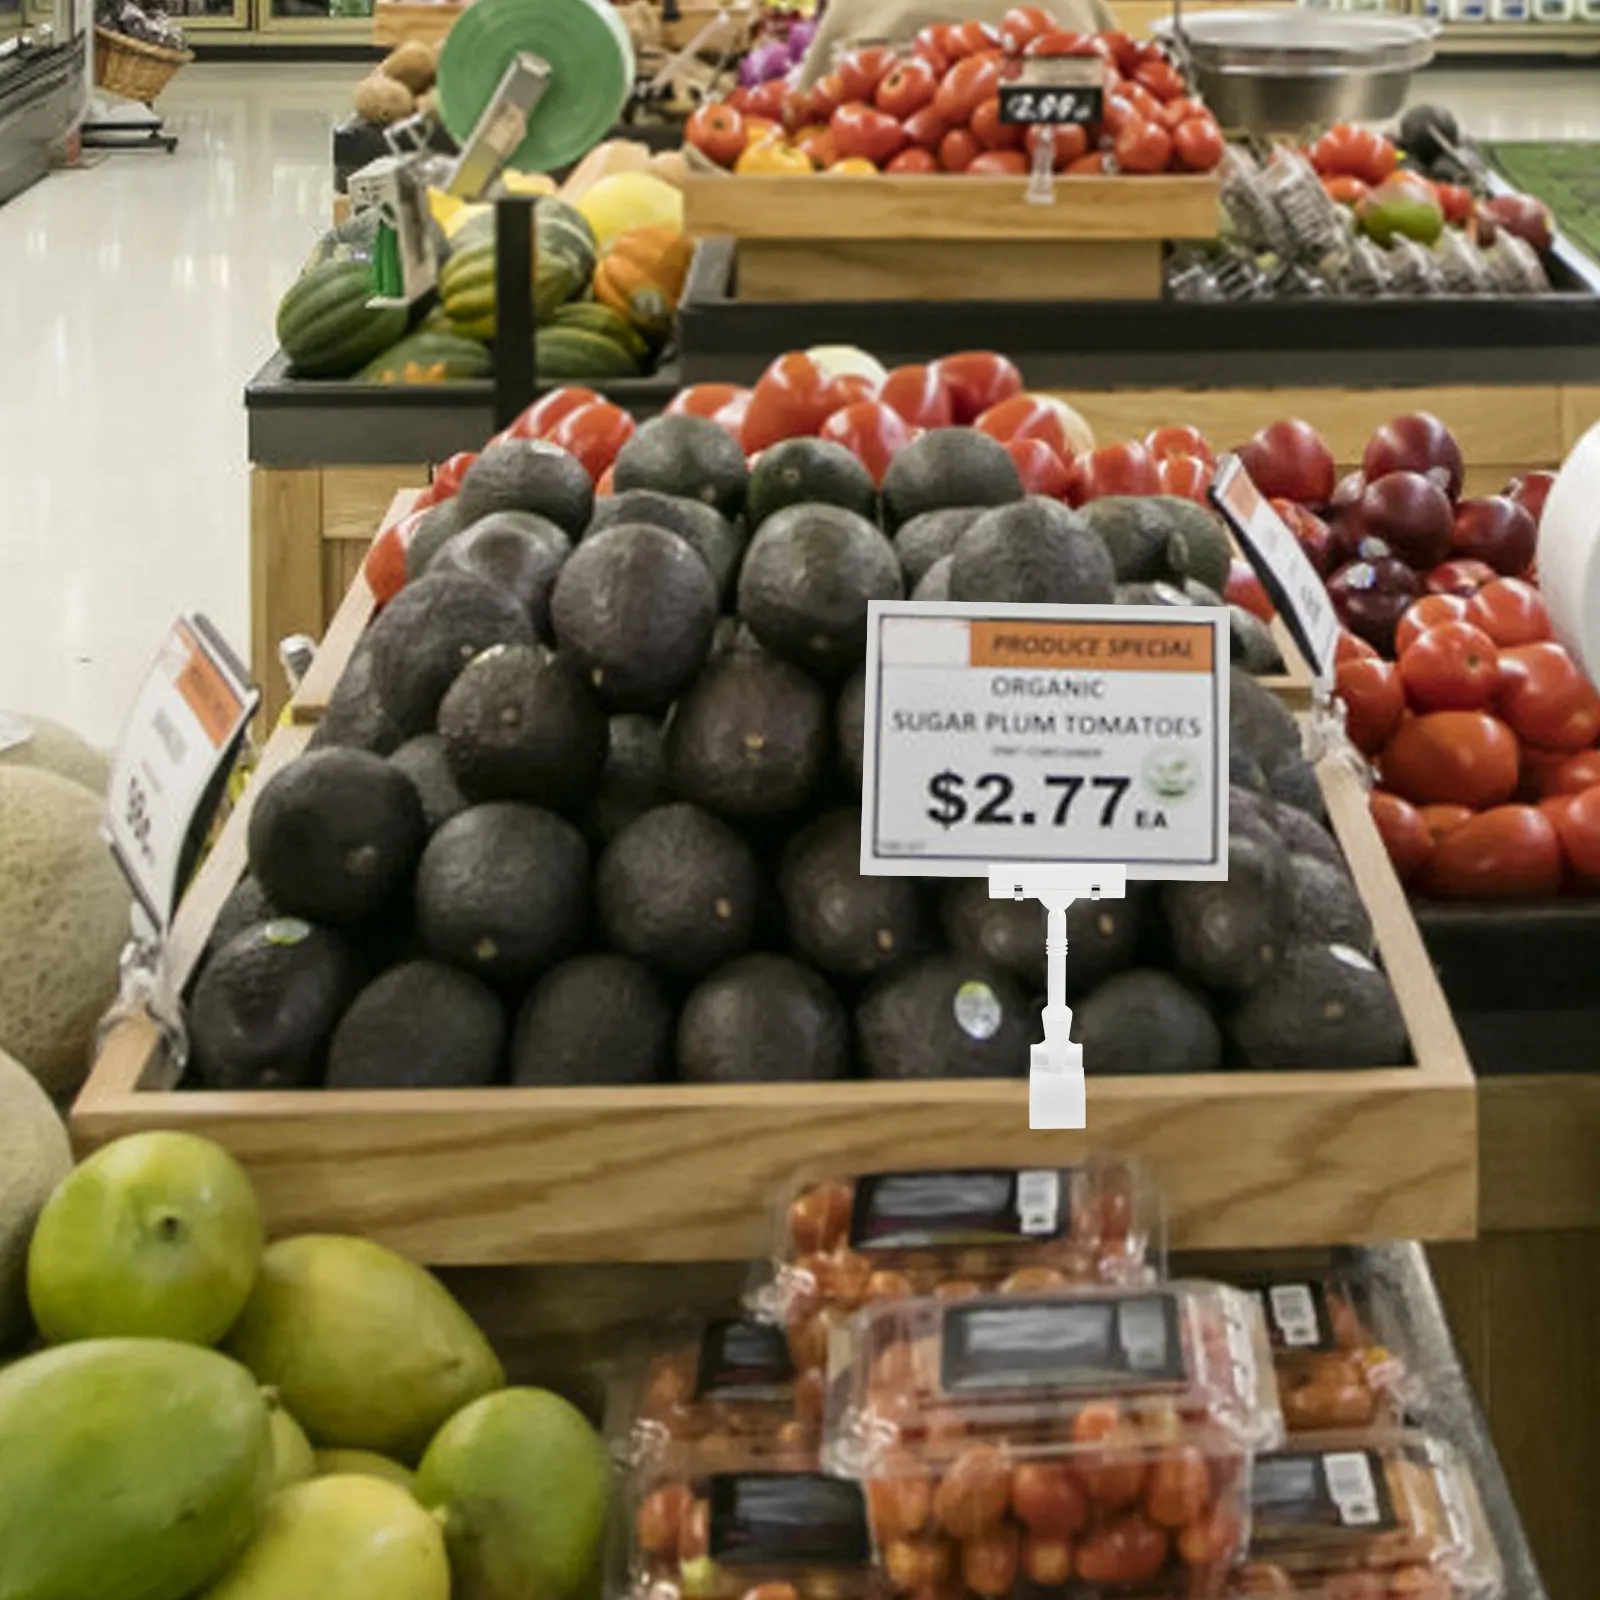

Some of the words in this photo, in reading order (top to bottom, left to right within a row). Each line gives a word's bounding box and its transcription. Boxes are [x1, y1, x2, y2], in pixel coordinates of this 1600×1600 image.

[992, 634, 1100, 656] PRODUCE
[1106, 637, 1193, 658] SPECIAL
[991, 676, 1105, 698] ORGANIC
[892, 711, 976, 733] SUGAR
[985, 713, 1055, 735] PLUM
[1064, 714, 1202, 738] TOMATOES
[926, 768, 1131, 831] $2.77
[1135, 810, 1168, 829] EA
